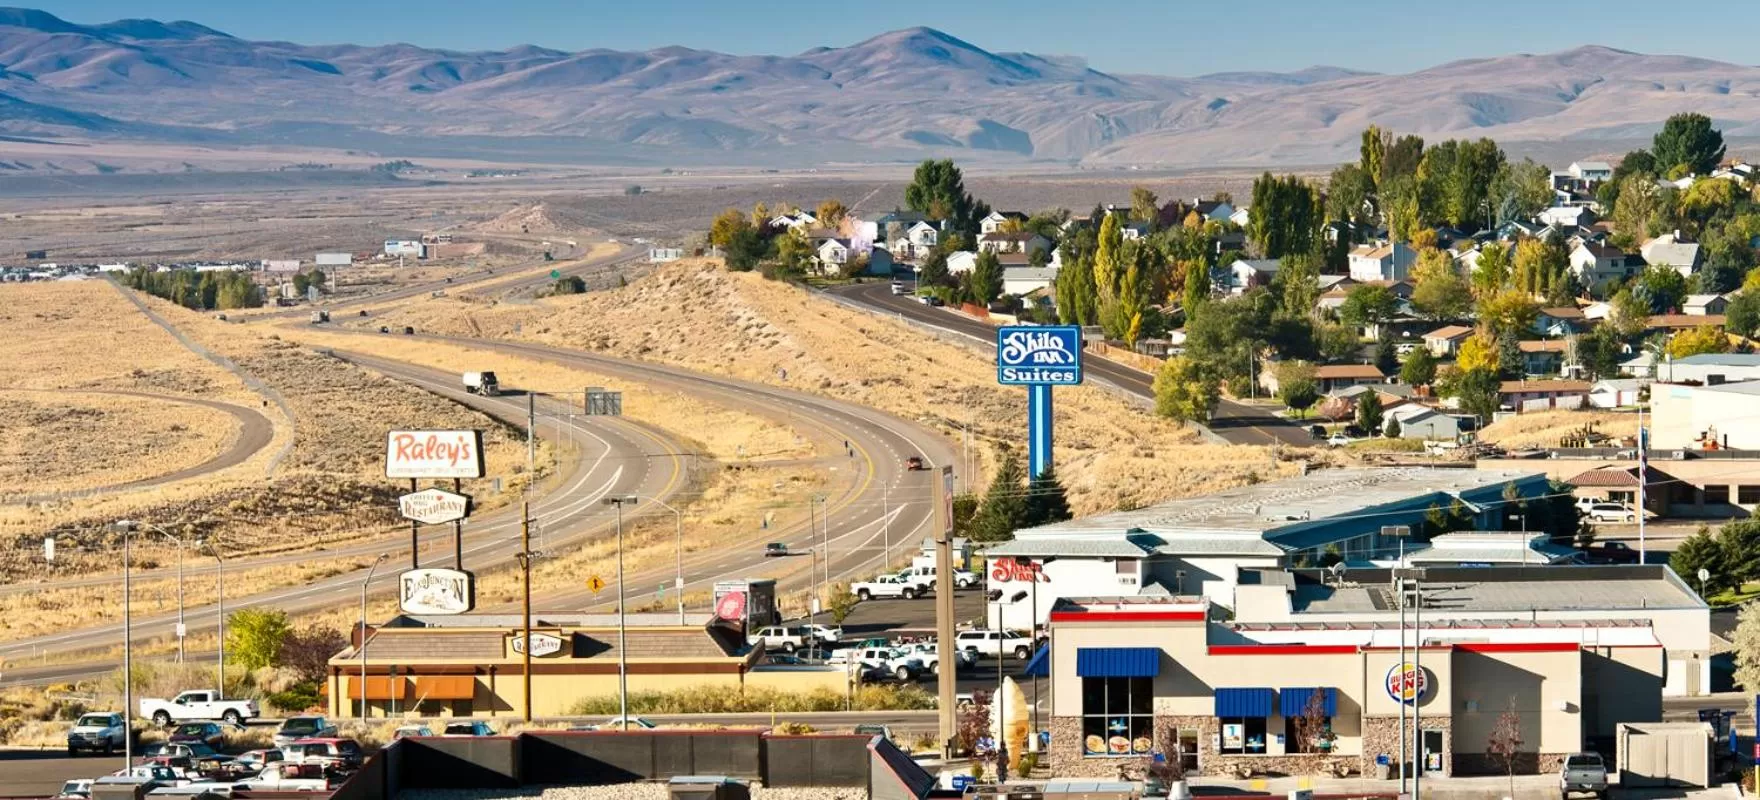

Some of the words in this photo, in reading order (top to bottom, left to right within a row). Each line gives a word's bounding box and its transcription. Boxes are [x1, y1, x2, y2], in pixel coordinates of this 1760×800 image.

[1002, 332, 1074, 364] Shilo
[1003, 368, 1074, 381] Suites
[394, 433, 470, 467] Raley's
[405, 500, 462, 518] RESTAURANT
[1392, 676, 1424, 694] KNG
